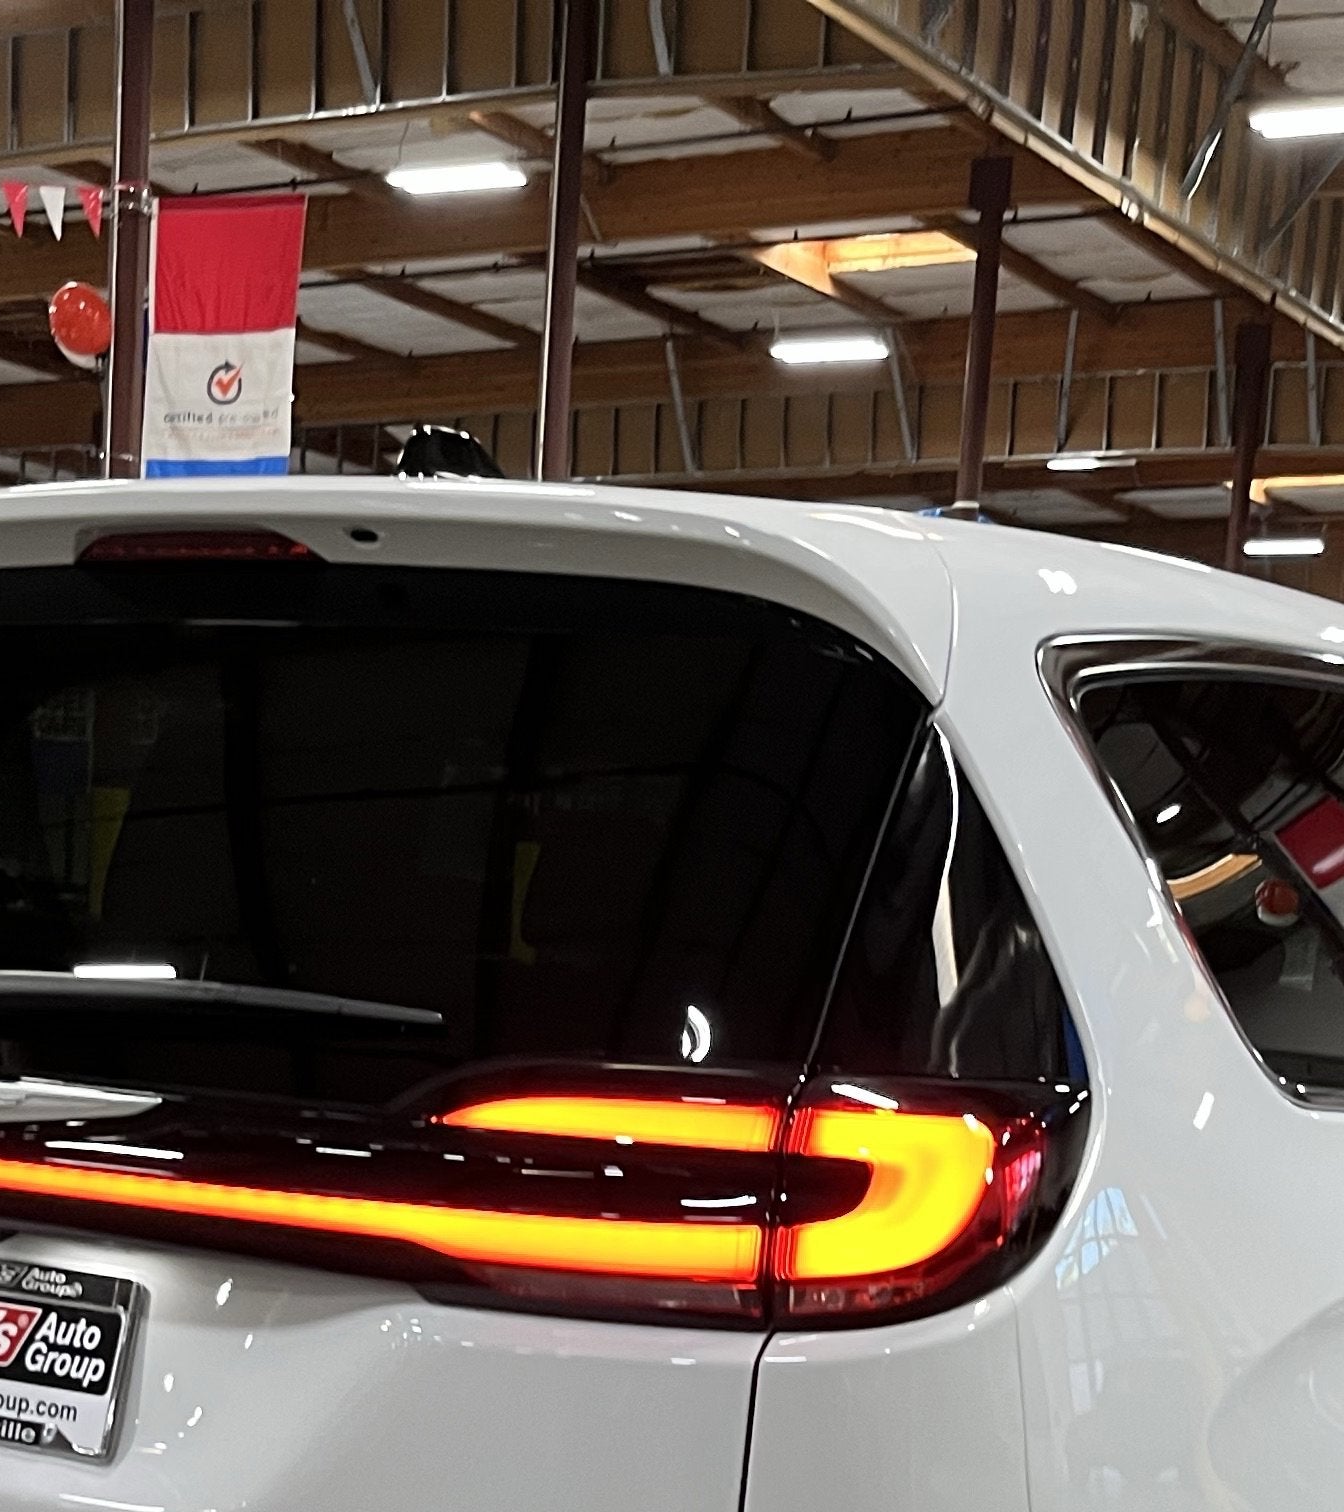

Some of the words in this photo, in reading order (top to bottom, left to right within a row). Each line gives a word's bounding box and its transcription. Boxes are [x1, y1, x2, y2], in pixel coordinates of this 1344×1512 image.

[22, 1276, 76, 1297] Group
[28, 1266, 67, 1285] Auto
[34, 1311, 102, 1351] Auto
[24, 1341, 106, 1388] Group
